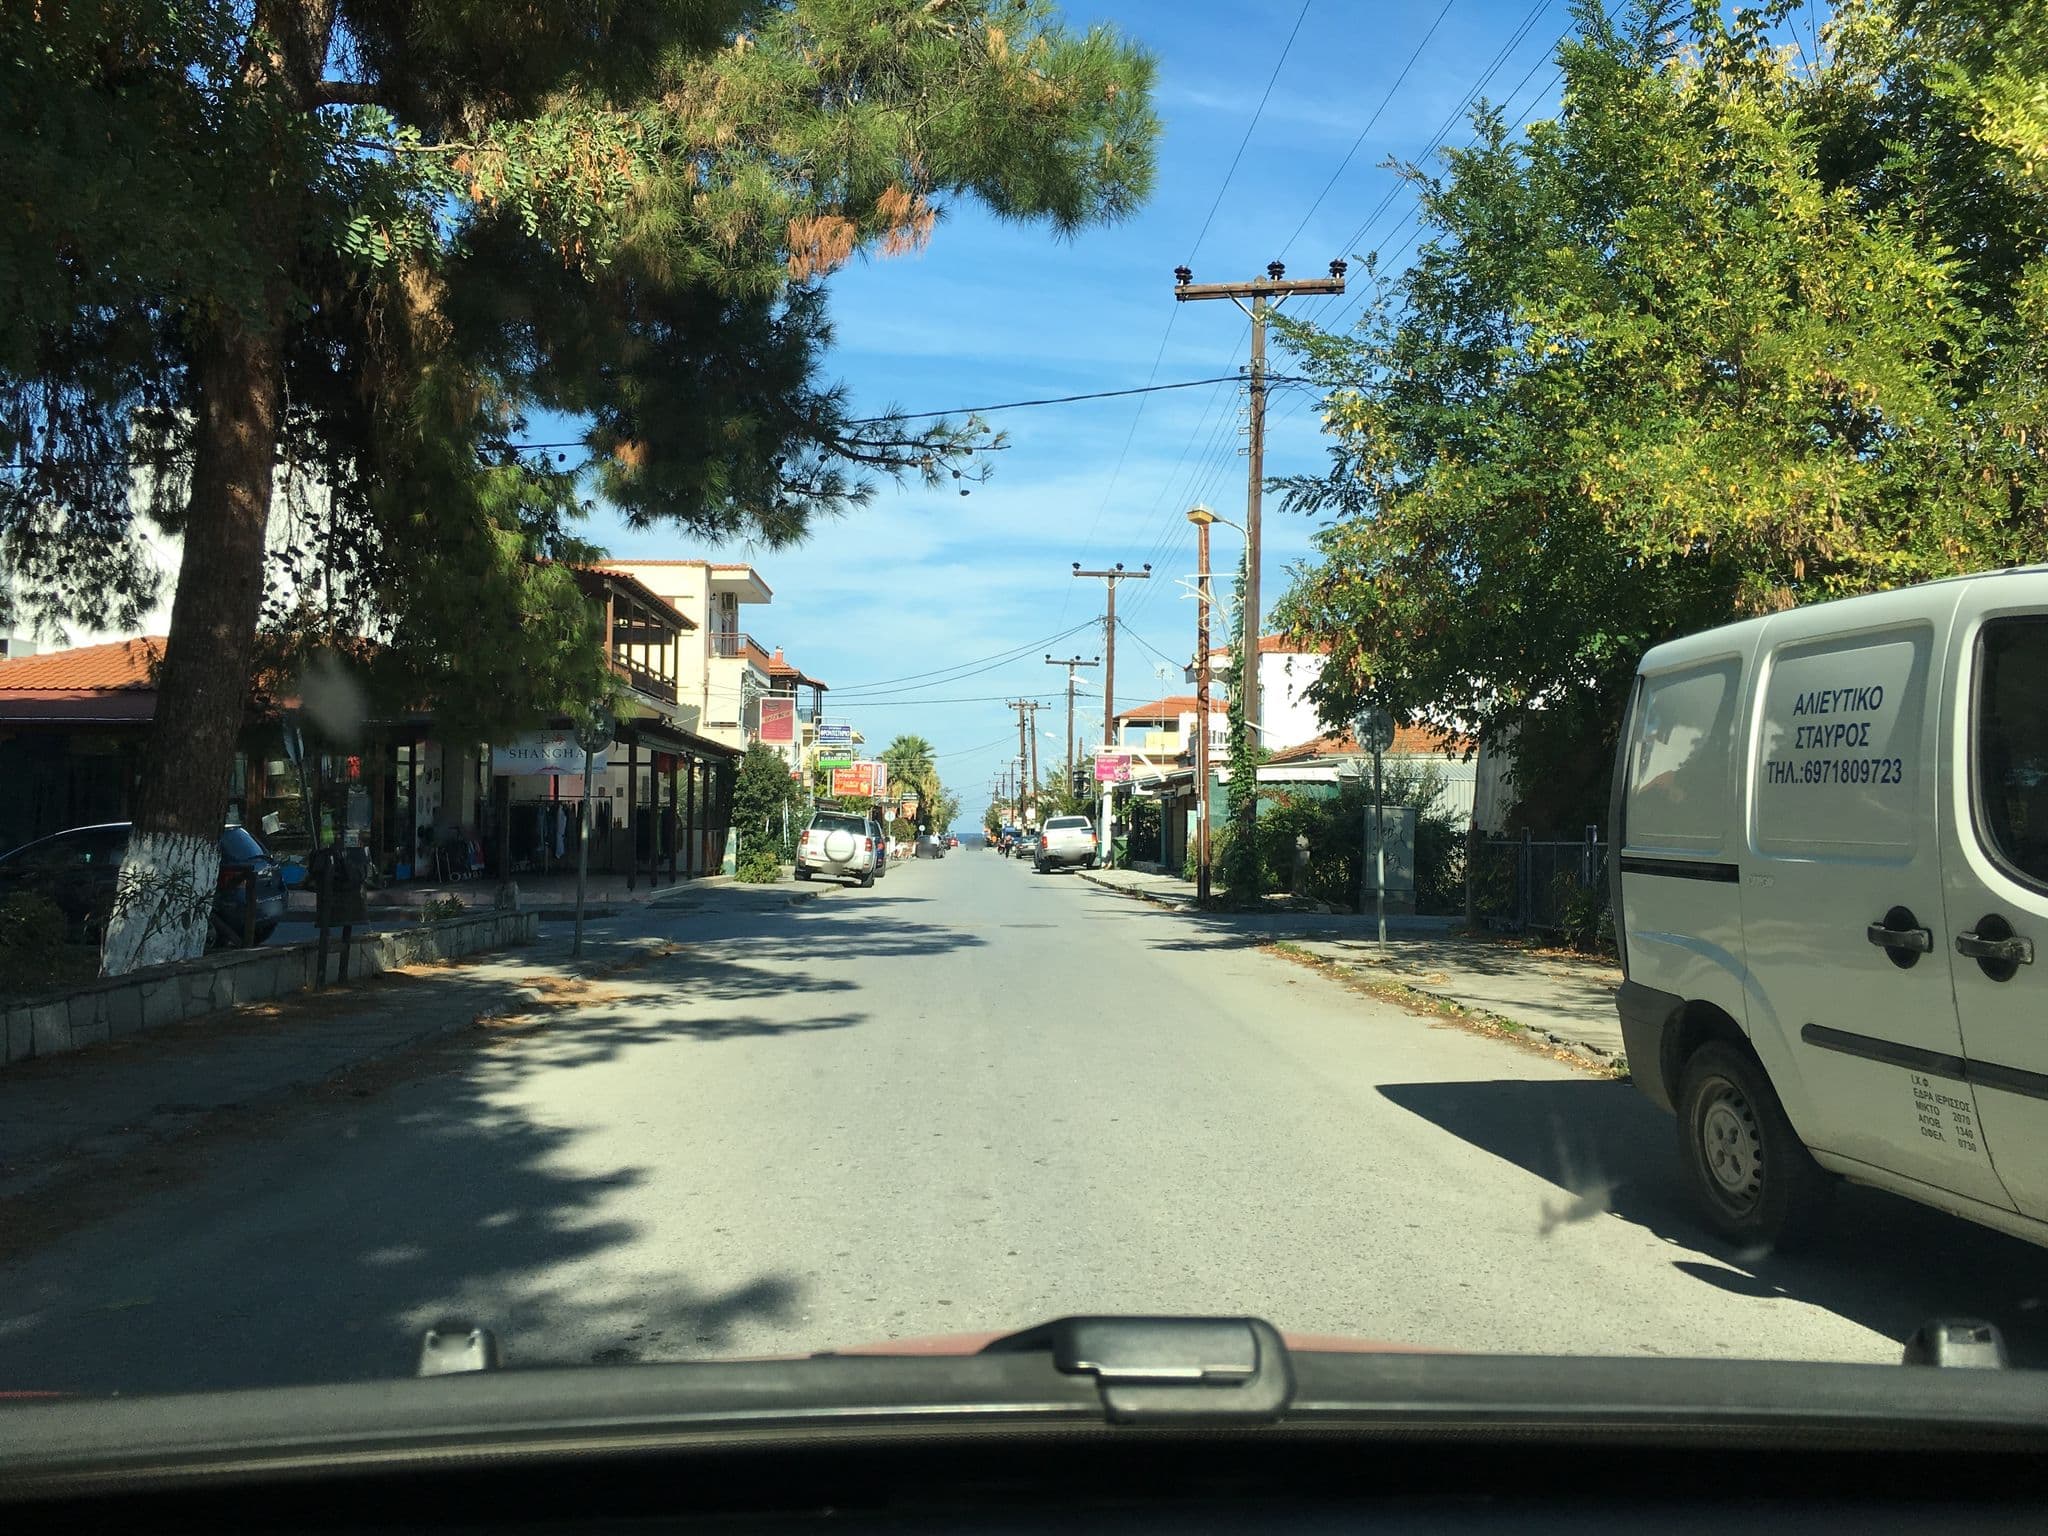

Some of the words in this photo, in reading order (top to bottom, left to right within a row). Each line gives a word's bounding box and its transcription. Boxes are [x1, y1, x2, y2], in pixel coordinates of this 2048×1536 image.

[1793, 686, 1883, 716] ΑΛΙΕΥΤΙΚΟ
[1795, 722, 1871, 749] ΣΤΑΥΡΟΣ
[509, 748, 588, 759] SHANGHA
[1767, 758, 1902, 784] ΤΗΛ.:6971809723
[1913, 1087, 1935, 1102] ΕΔΡΑ
[1935, 1093, 1972, 1113] ΙΕΡΙΣΣΟΣ
